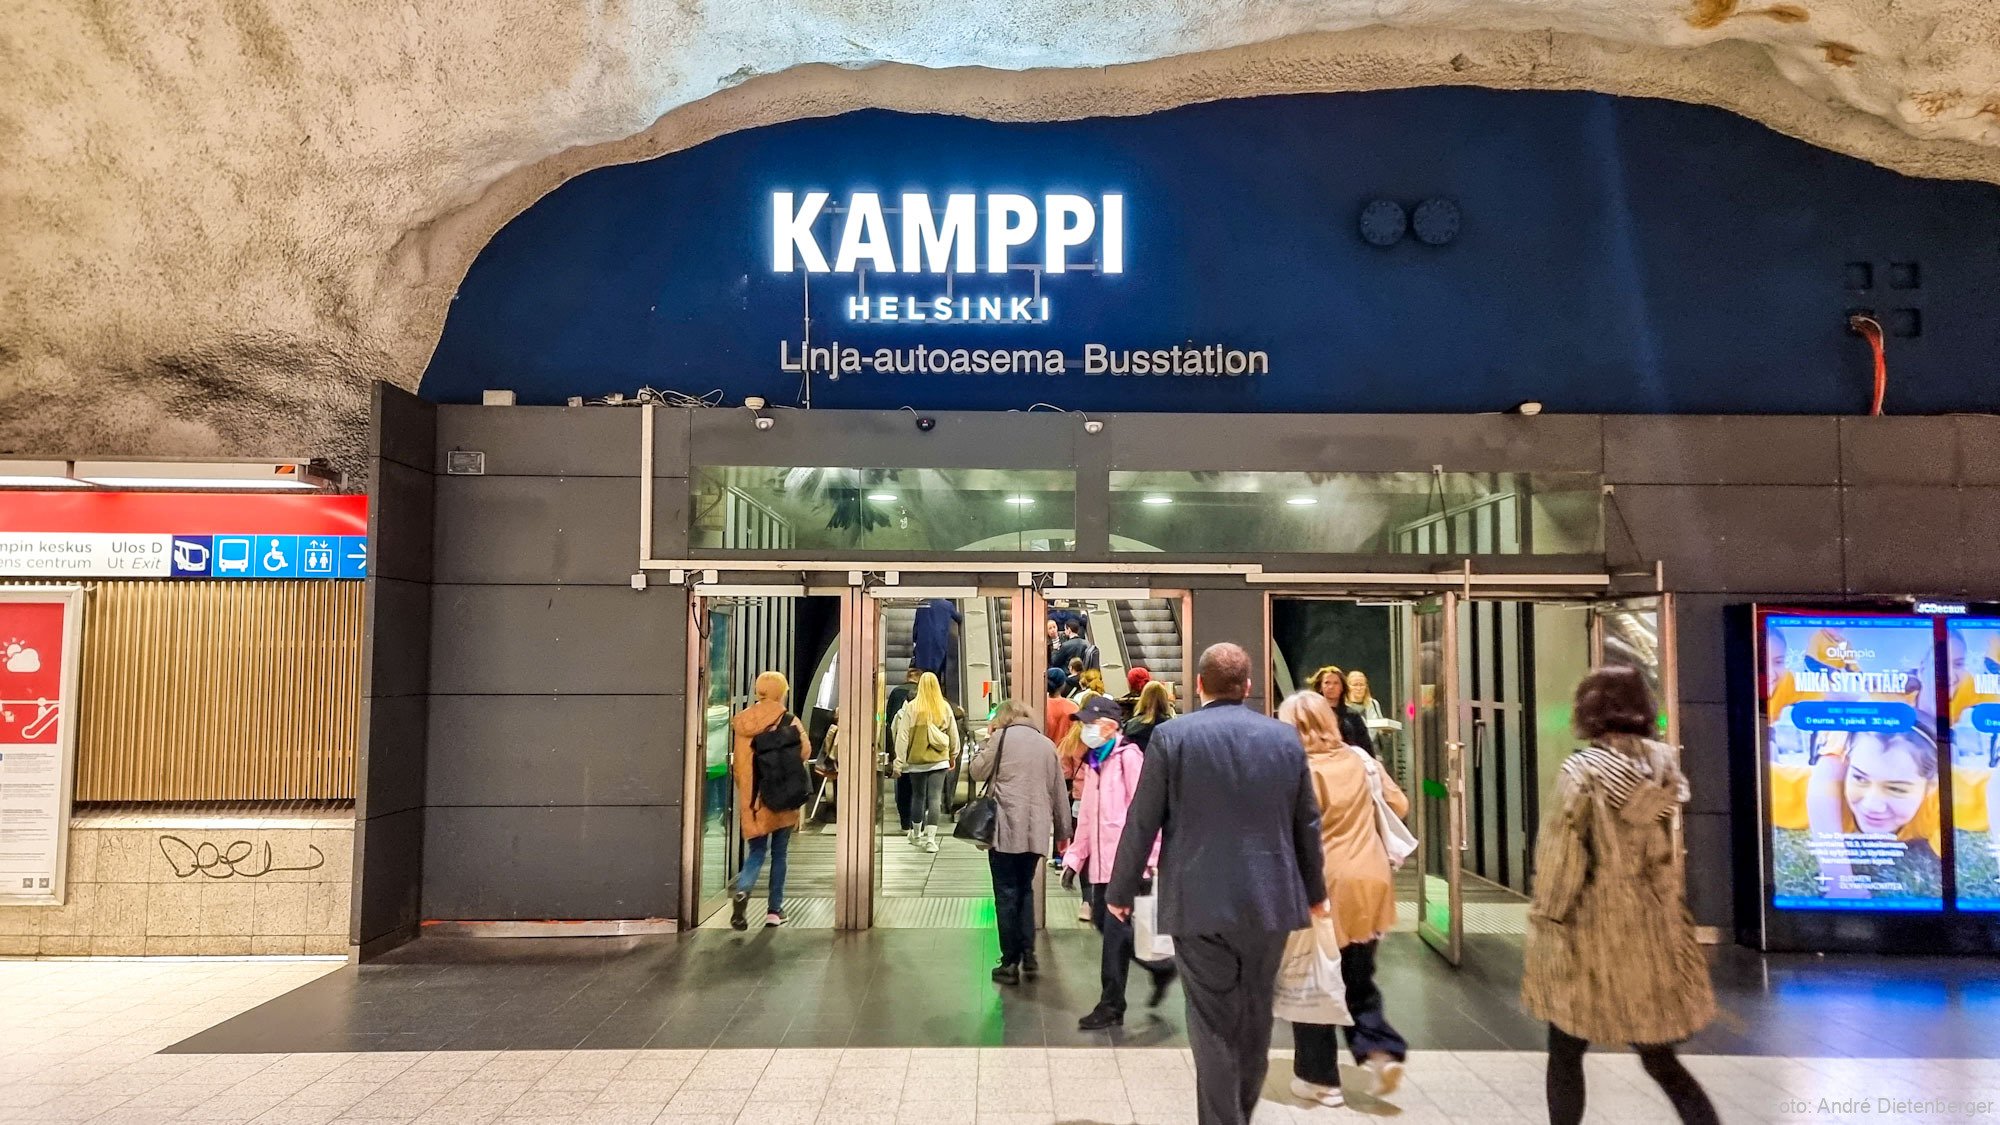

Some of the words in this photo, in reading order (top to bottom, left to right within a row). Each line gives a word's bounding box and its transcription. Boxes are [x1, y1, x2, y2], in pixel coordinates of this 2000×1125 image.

[773, 192, 1123, 274] KAMPPI
[849, 296, 1049, 322] HELSINKI
[779, 340, 1065, 380] Linja-autoasema
[1084, 343, 1270, 374] Busstation
[39, 541, 92, 553] keskus
[112, 541, 146, 553] Ulos
[152, 542, 163, 553] D
[26, 557, 92, 568] centrum
[107, 557, 125, 569] Ut
[132, 557, 162, 569] Exit
[1825, 645, 1876, 661] Olympia
[1795, 668, 1831, 692] MIKÄ
[1831, 669, 1908, 693] SYTYTTÄÄ?
